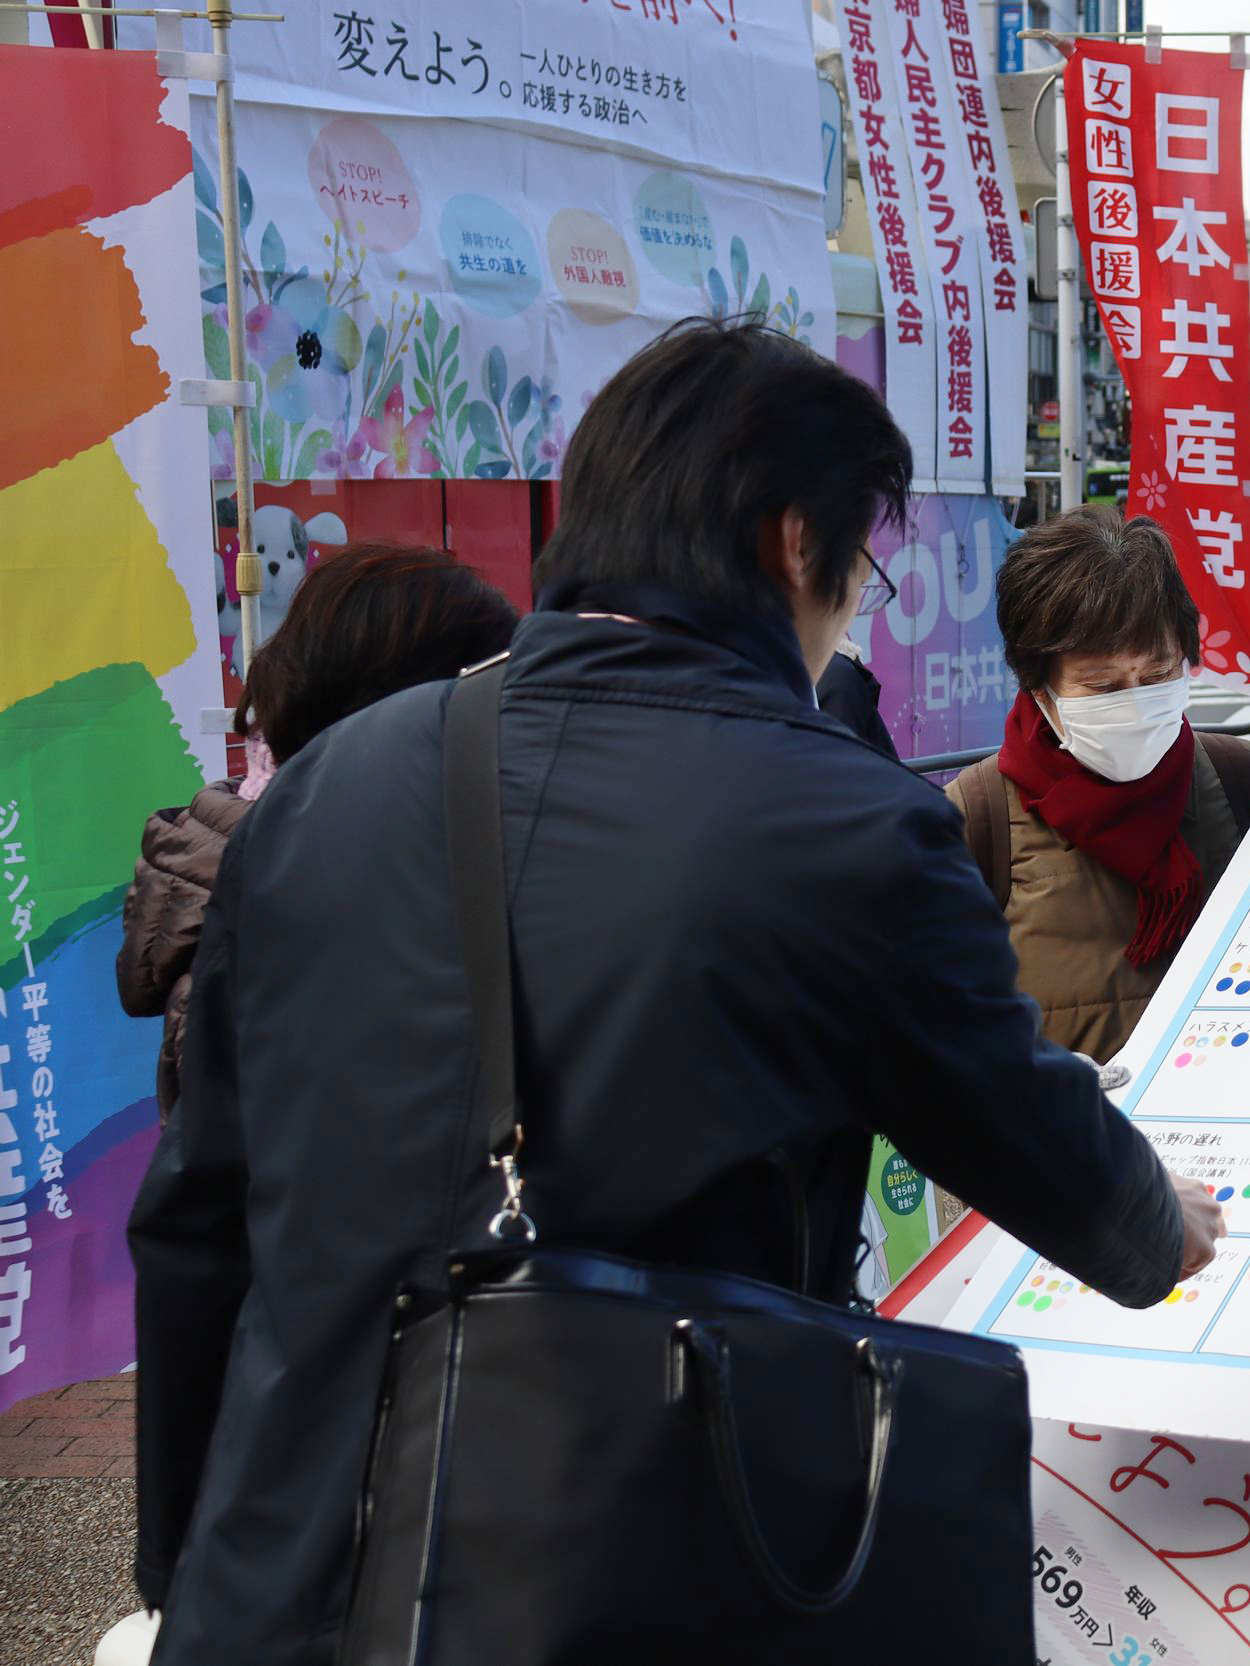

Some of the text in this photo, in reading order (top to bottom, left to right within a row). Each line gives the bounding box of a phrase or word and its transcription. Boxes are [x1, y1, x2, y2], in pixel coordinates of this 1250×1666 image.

[333, 11, 512, 98] 変えよう。
[520, 48, 686, 102] 一人ひとりの生き方を
[523, 81, 648, 125] 応援する政治へ
[339, 161, 382, 184] STOP!
[320, 184, 409, 209] ヘイトスピーチ
[1089, 67, 1137, 354] 女性後援会
[459, 253, 527, 275] 共生の道を
[571, 246, 609, 264] STOP!
[1152, 92, 1245, 590] 日本共産党
[925, 645, 1017, 711] 日本共
[0, 800, 73, 1219] ジェンダー平等の社会を
[887, 1169, 918, 1187] 自分らしく
[891, 1183, 917, 1199] 生きられる
[897, 1197, 914, 1210] 社会に
[1064, 1546, 1083, 1567] 男性
[1124, 1584, 1157, 1621] 年収
[1149, 1636, 1168, 1658] 女性
